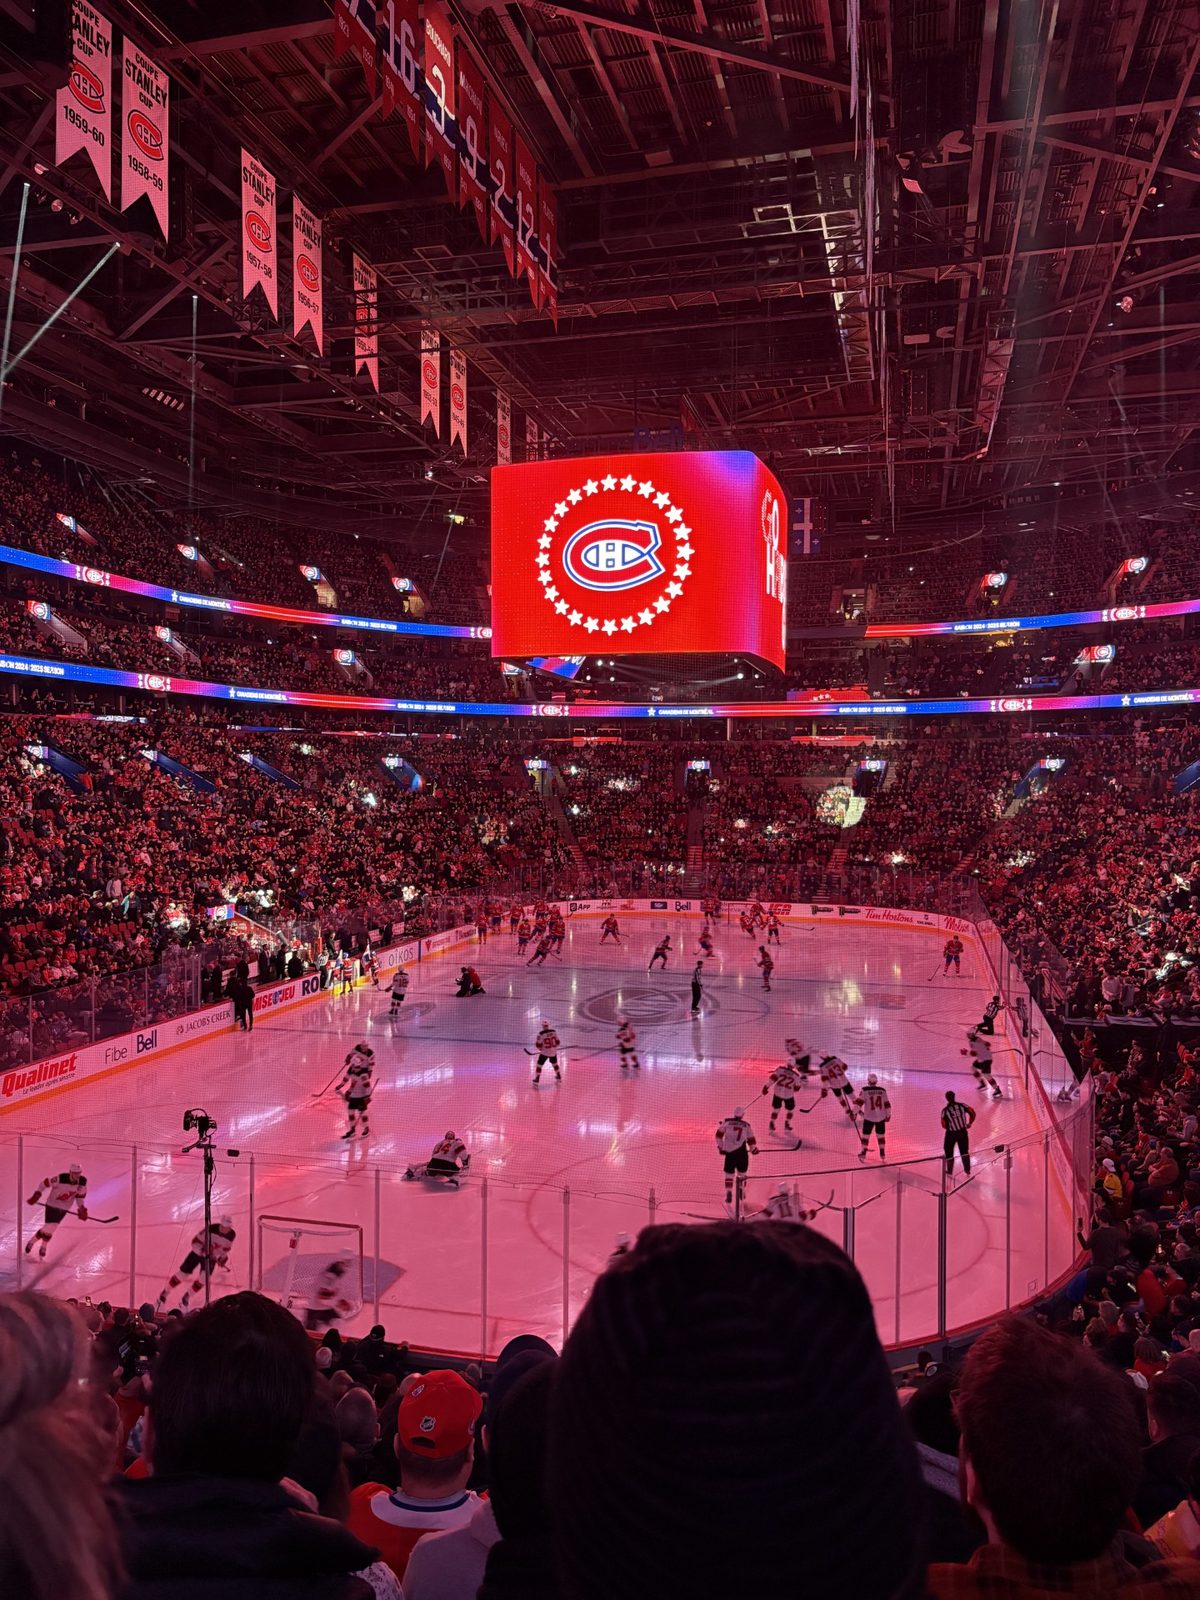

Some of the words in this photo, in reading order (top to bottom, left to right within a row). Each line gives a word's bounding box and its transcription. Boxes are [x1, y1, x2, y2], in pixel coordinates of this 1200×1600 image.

[77, 37, 94, 58] CUP
[135, 52, 159, 81] COUPE
[125, 58, 168, 109] STANLEY
[139, 93, 154, 110] CUP
[64, 105, 105, 147] 1959-60
[128, 154, 163, 192] 1958-59
[242, 168, 275, 207] STANLEY
[294, 213, 321, 249] STANLEY
[246, 250, 273, 280] 1957-58
[675, 901, 691, 911] Bell
[865, 908, 881, 920] Tim
[882, 910, 914, 924] Hortons
[105, 1046, 128, 1065] Fibe
[136, 1029, 158, 1054] Bell
[543, 1037, 557, 1049] 90
[1, 1053, 79, 1098] Qualinet
[777, 1073, 795, 1089] 22
[869, 1095, 883, 1111] 14
[733, 1126, 743, 1142] 7
